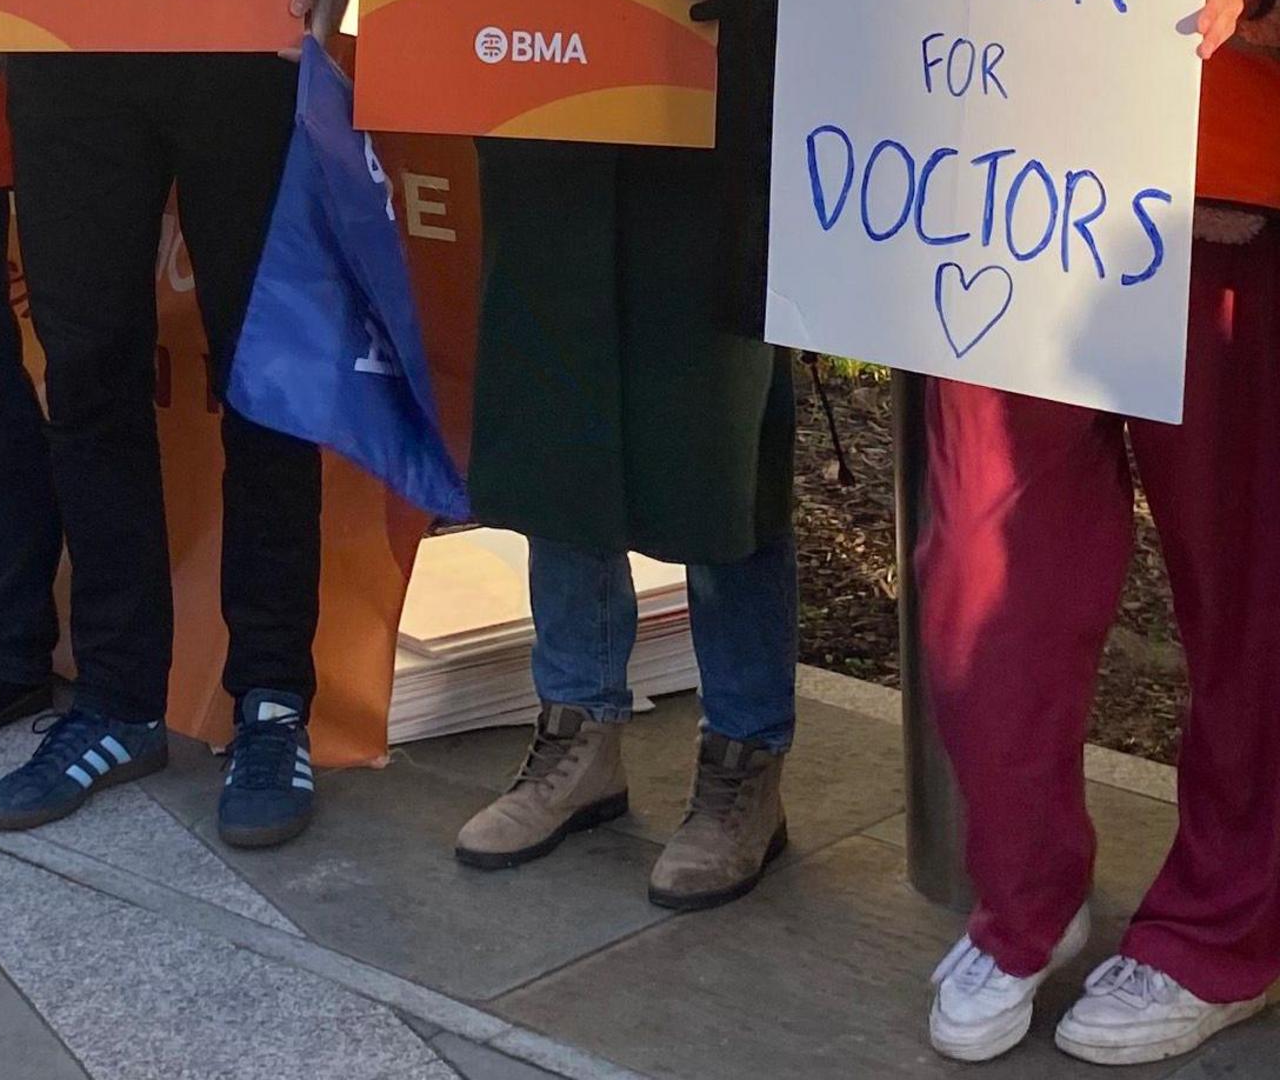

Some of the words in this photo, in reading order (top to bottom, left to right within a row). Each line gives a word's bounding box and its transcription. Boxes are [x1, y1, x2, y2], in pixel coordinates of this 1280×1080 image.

[511, 30, 587, 65] BMA
[921, 32, 1009, 99] FOR
[805, 124, 1173, 287] DOCTORS
